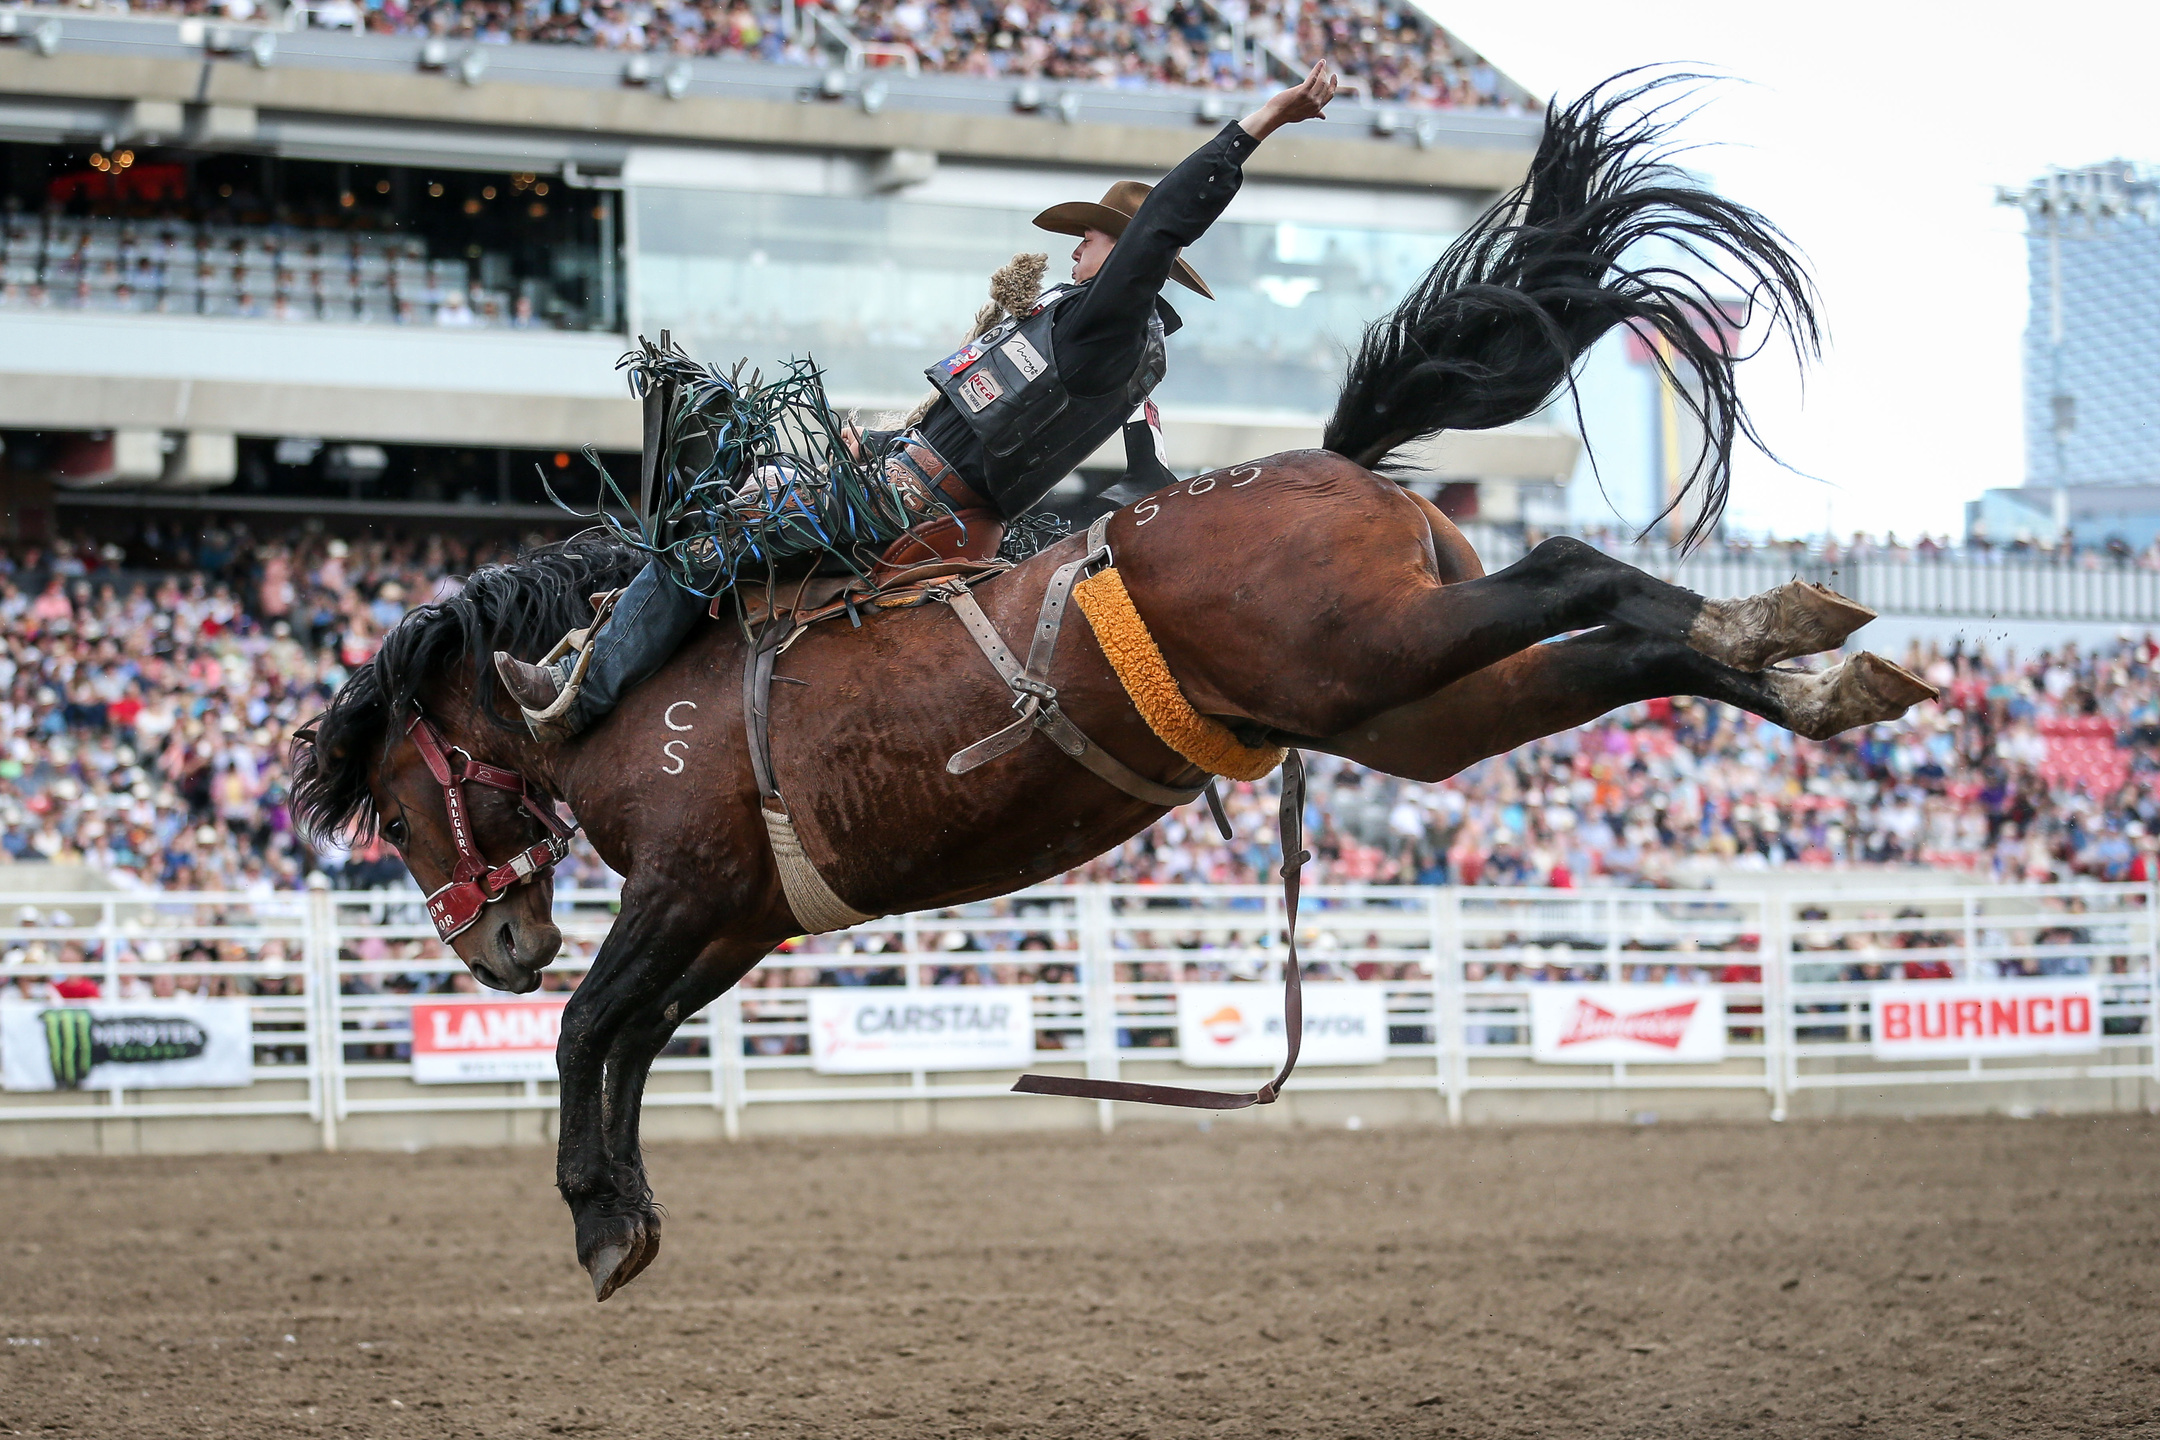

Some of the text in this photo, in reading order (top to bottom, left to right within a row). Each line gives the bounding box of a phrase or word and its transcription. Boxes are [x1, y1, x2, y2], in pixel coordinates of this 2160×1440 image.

[448, 788, 470, 856] CALGARY
[855, 1003, 1011, 1034] CARSTAR
[1881, 994, 2092, 1042] BURNCO
